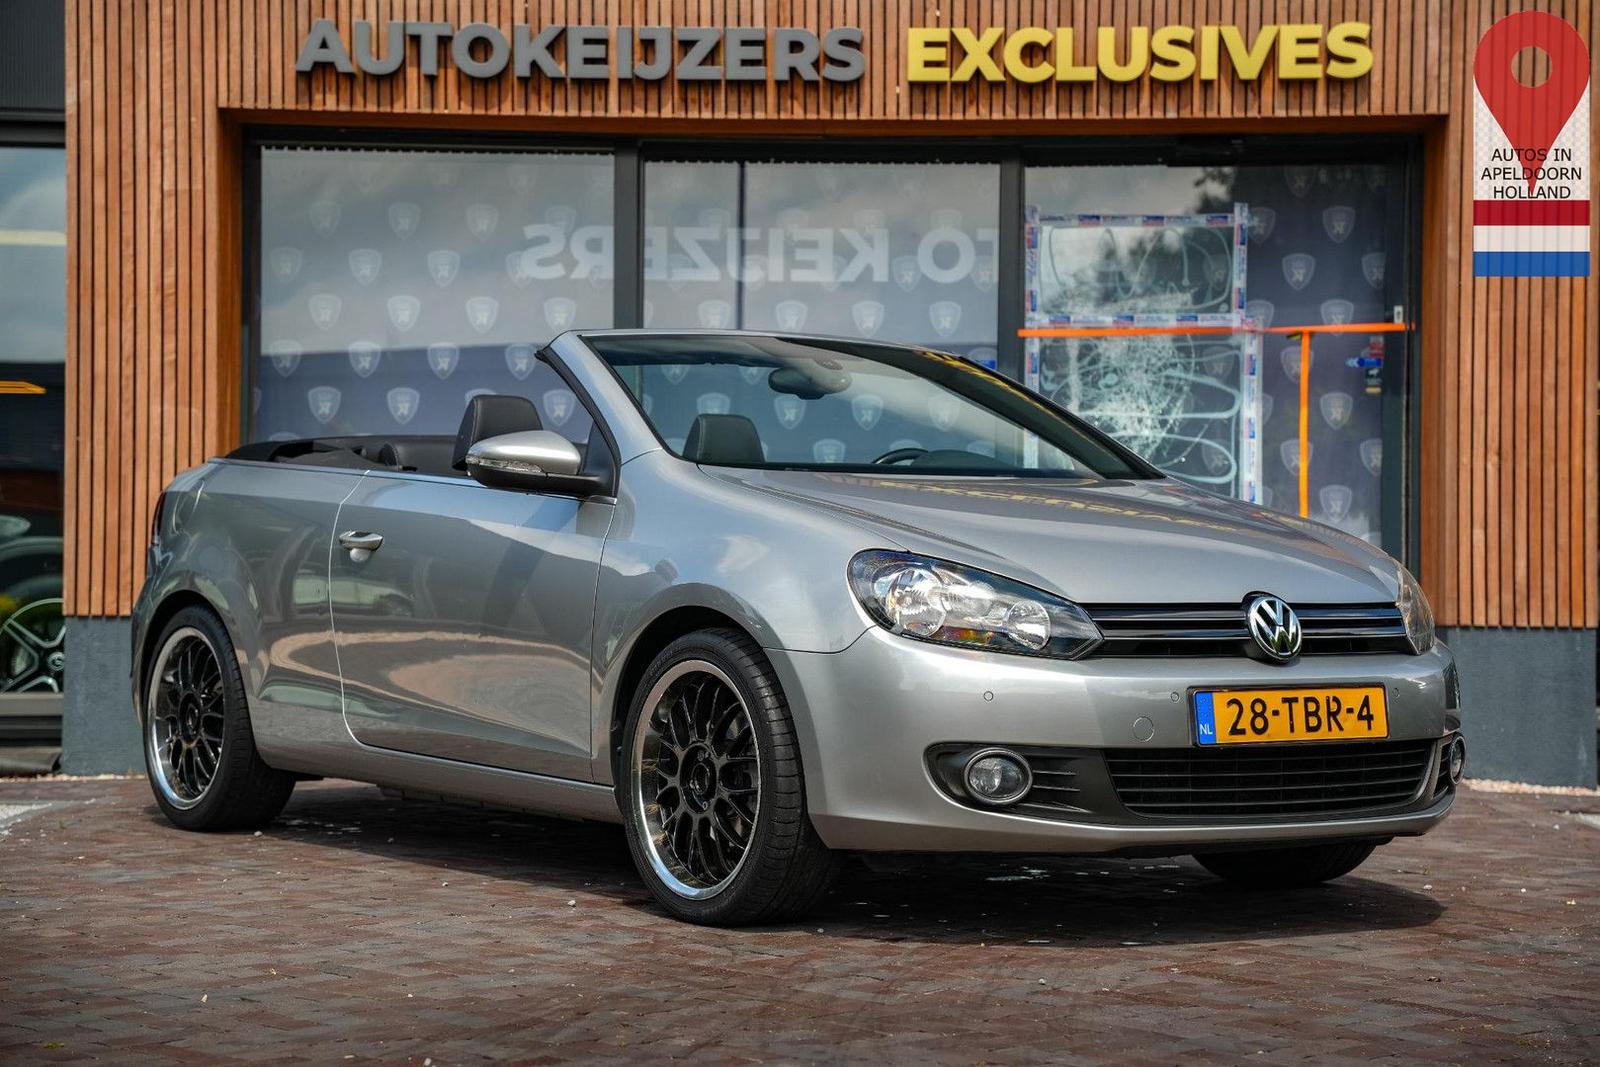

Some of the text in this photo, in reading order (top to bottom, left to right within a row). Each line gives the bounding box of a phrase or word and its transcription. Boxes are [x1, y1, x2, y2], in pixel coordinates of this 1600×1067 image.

[296, 19, 1372, 82] AUTOKEIJZERS EXCLUSIVES
[1200, 723, 1213, 735] NL
[1226, 695, 1374, 735] 28-TBR-4
